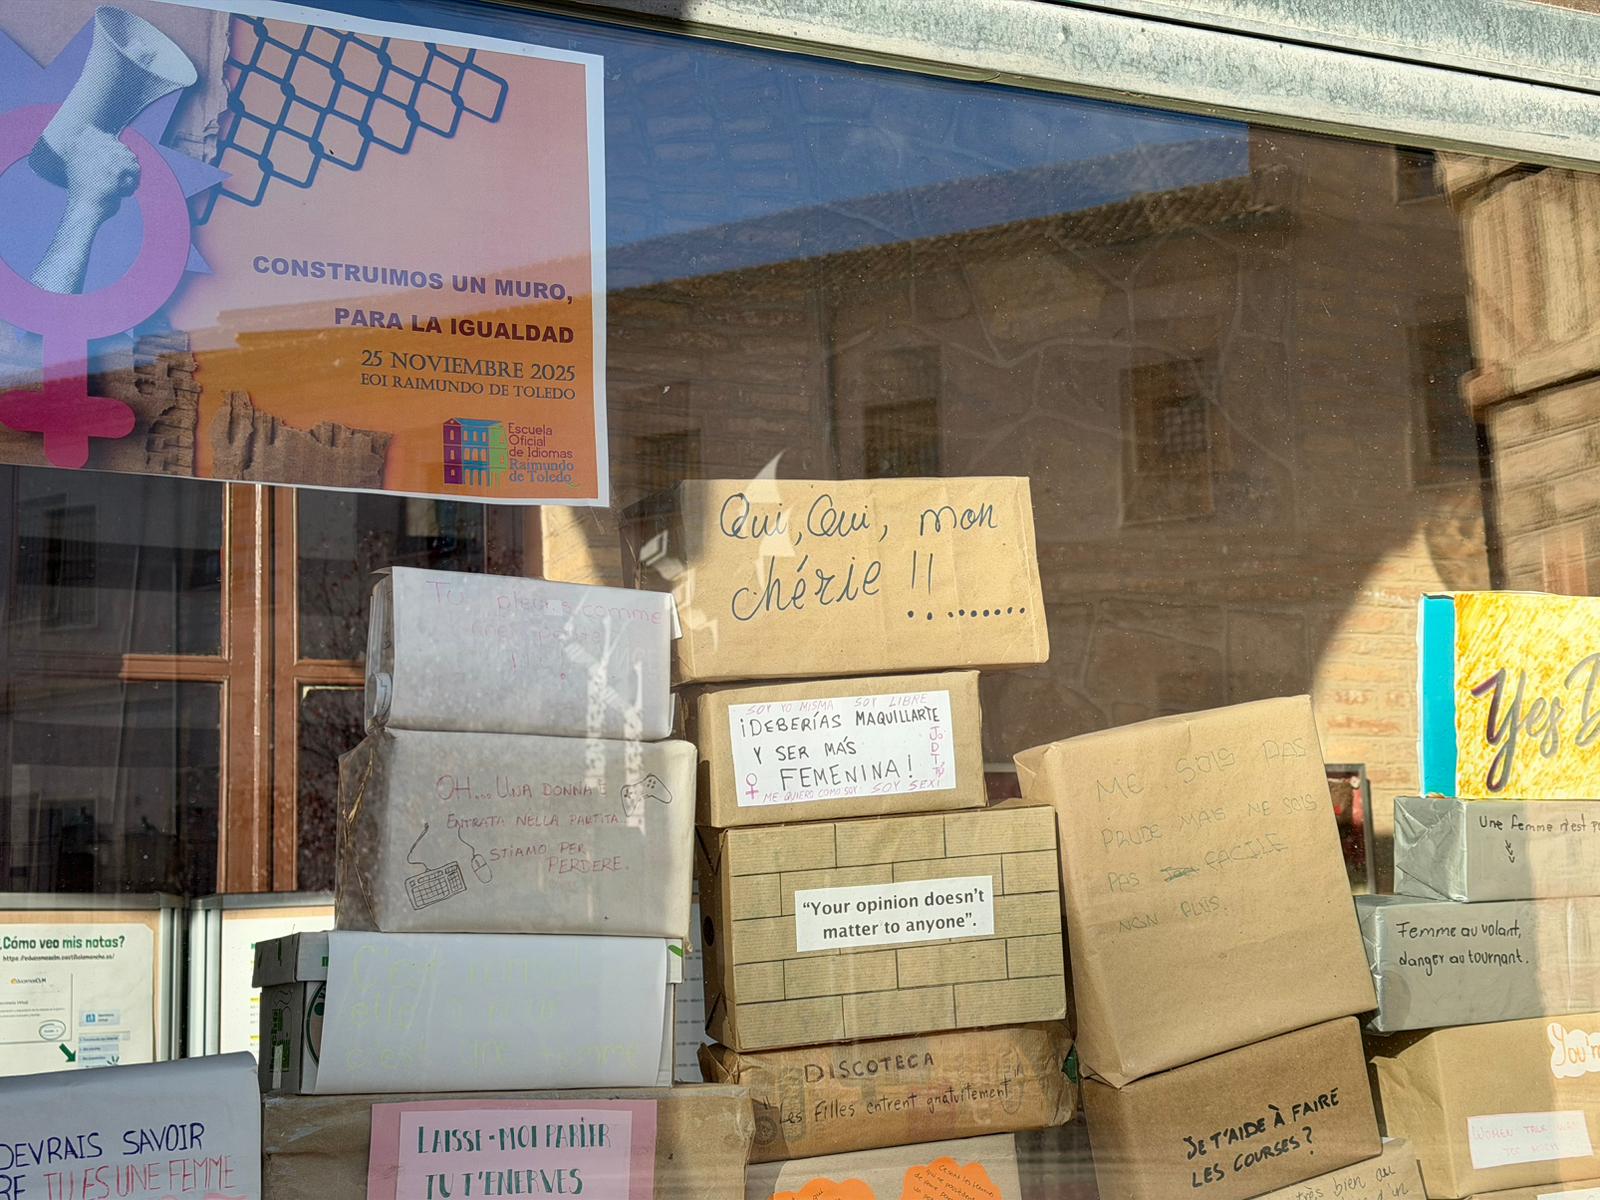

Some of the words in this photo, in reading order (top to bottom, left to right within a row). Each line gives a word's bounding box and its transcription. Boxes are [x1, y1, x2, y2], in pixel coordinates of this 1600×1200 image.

[253, 256, 443, 289] CONSTRUIMOS
[452, 275, 485, 294] UN
[495, 279, 573, 304] MURO,
[335, 308, 403, 330] PARA
[411, 315, 442, 333] LA
[451, 318, 574, 343] IGUALDAD
[361, 350, 382, 366] 25
[390, 352, 524, 378] NOVIEMBRE
[531, 364, 576, 381] 2025
[361, 373, 388, 387] EOI
[393, 375, 484, 395] RAIMUNDO
[490, 384, 509, 396] DE
[513, 385, 576, 400] TOLEDO
[508, 422, 553, 435] Escuela
[509, 434, 546, 447] Oficial
[509, 447, 524, 457] de
[528, 447, 573, 459] Idiomas
[510, 459, 575, 472] Raimundo
[509, 472, 524, 482] de
[527, 471, 572, 483] Toledo
[732, 554, 881, 621] chérie
[799, 699, 834, 712] MISMA
[854, 696, 879, 707] SOY
[888, 693, 927, 707] LIBRE
[856, 706, 940, 727] MAQUILLARTE
[1471, 667, 1565, 792] Yes
[753, 746, 762, 765] Y
[775, 745, 810, 762] SER
[824, 736, 857, 757] MÁS
[1262, 737, 1306, 768] PAS
[763, 791, 777, 802] ME
[784, 789, 814, 801] QUIERO
[818, 787, 841, 798] COMO
[844, 785, 858, 796] SOY
[871, 782, 900, 794] SOY
[1479, 815, 1503, 831] Une
[1511, 814, 1553, 831] femme
[1560, 813, 1586, 831] n'est
[1101, 823, 1163, 849] PRUDE
[560, 842, 586, 854] PER
[1107, 872, 1140, 893] PAS
[856, 895, 918, 914] opinion
[823, 923, 879, 939] matter
[884, 921, 900, 934] to
[1396, 921, 1456, 938] Femme
[1461, 925, 1478, 938] au
[39, 939, 59, 949] veo
[62, 936, 82, 949] mis
[86, 935, 125, 949] notas?
[1399, 951, 1444, 976] danger
[1450, 954, 1465, 964] au
[804, 1052, 934, 1083] DISCOTECA
[1268, 1104, 1286, 1128] À
[123, 1122, 205, 1155] SAVOIR
[117, 1163, 160, 1197] UNE
[169, 1155, 235, 1191] FEMME
[425, 1172, 454, 1200] TU
[1192, 1163, 1225, 1188] LES
[1333, 1177, 1366, 1197] bien
